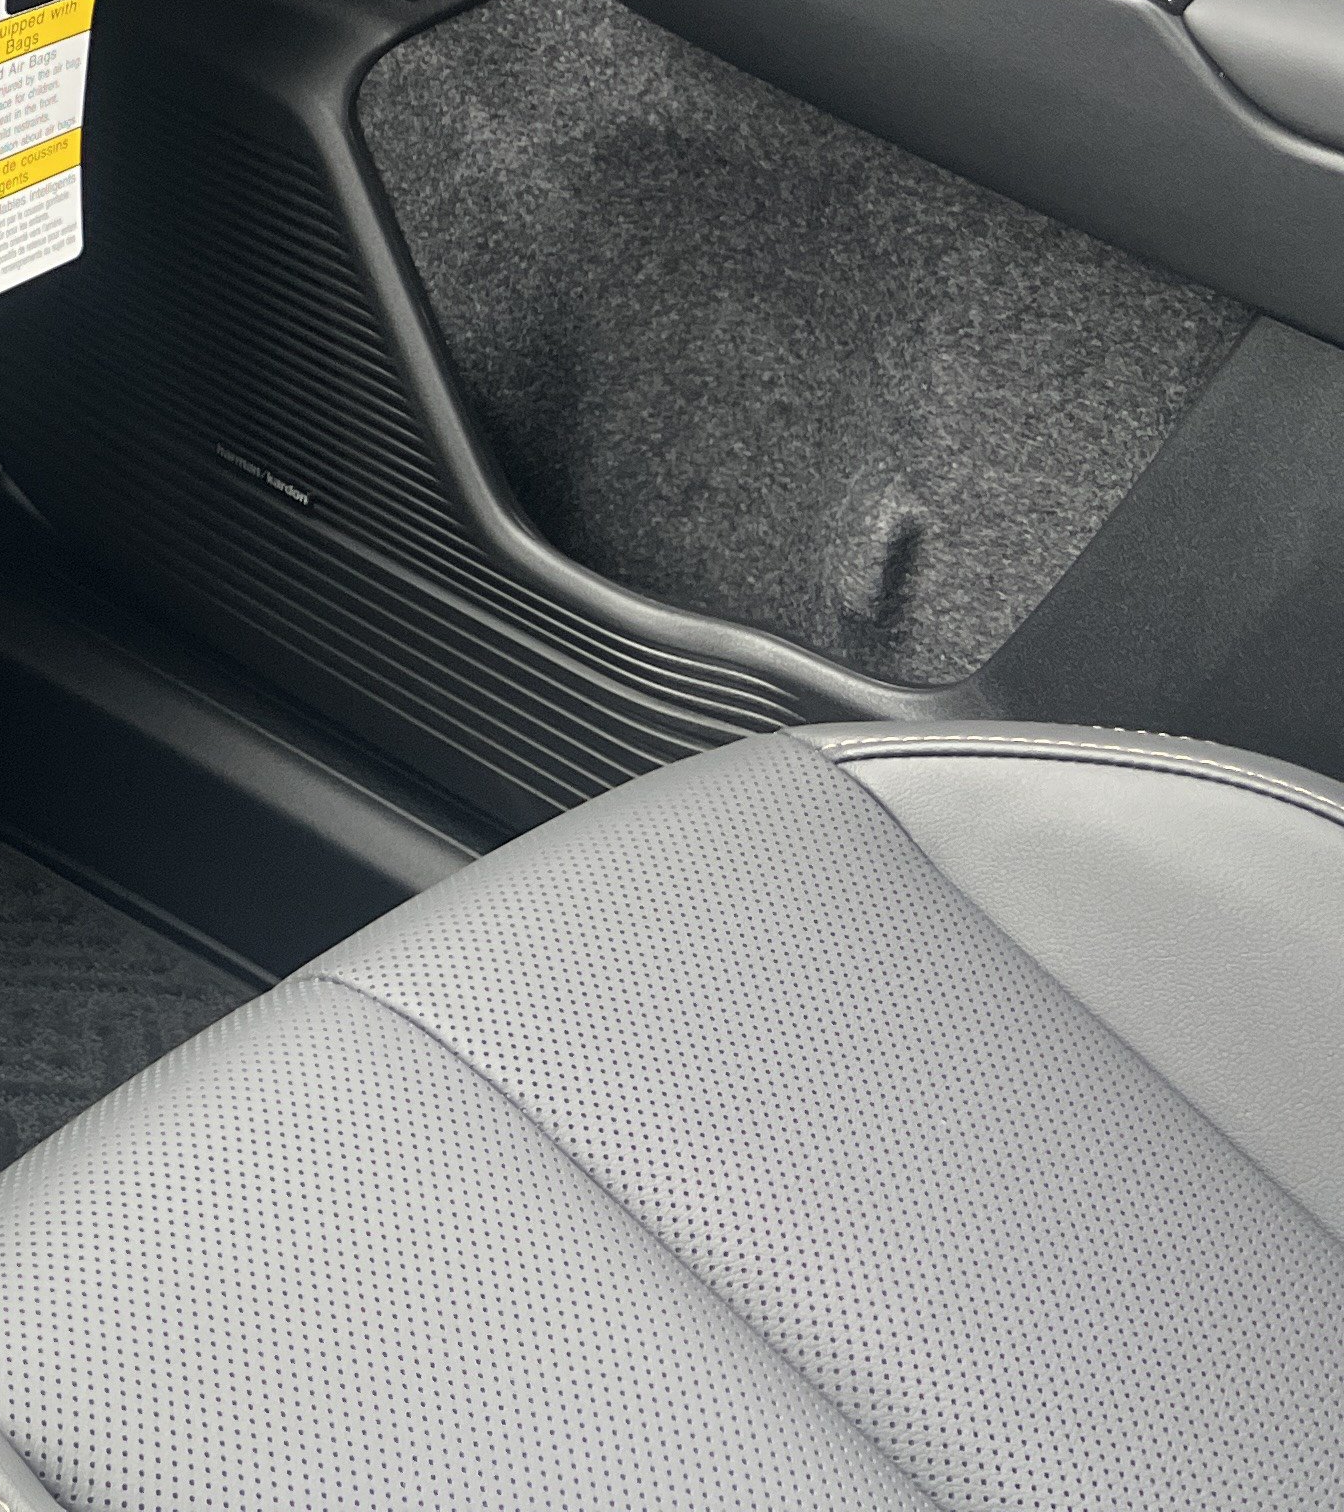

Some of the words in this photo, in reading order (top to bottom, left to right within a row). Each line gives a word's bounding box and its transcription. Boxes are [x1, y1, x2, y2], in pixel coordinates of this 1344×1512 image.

[51, 0, 78, 20] with
[6, 33, 40, 56] Bags
[8, 61, 25, 76] Air
[29, 49, 57, 69] Bags
[2, 160, 17, 175] de
[20, 137, 69, 168] coussins
